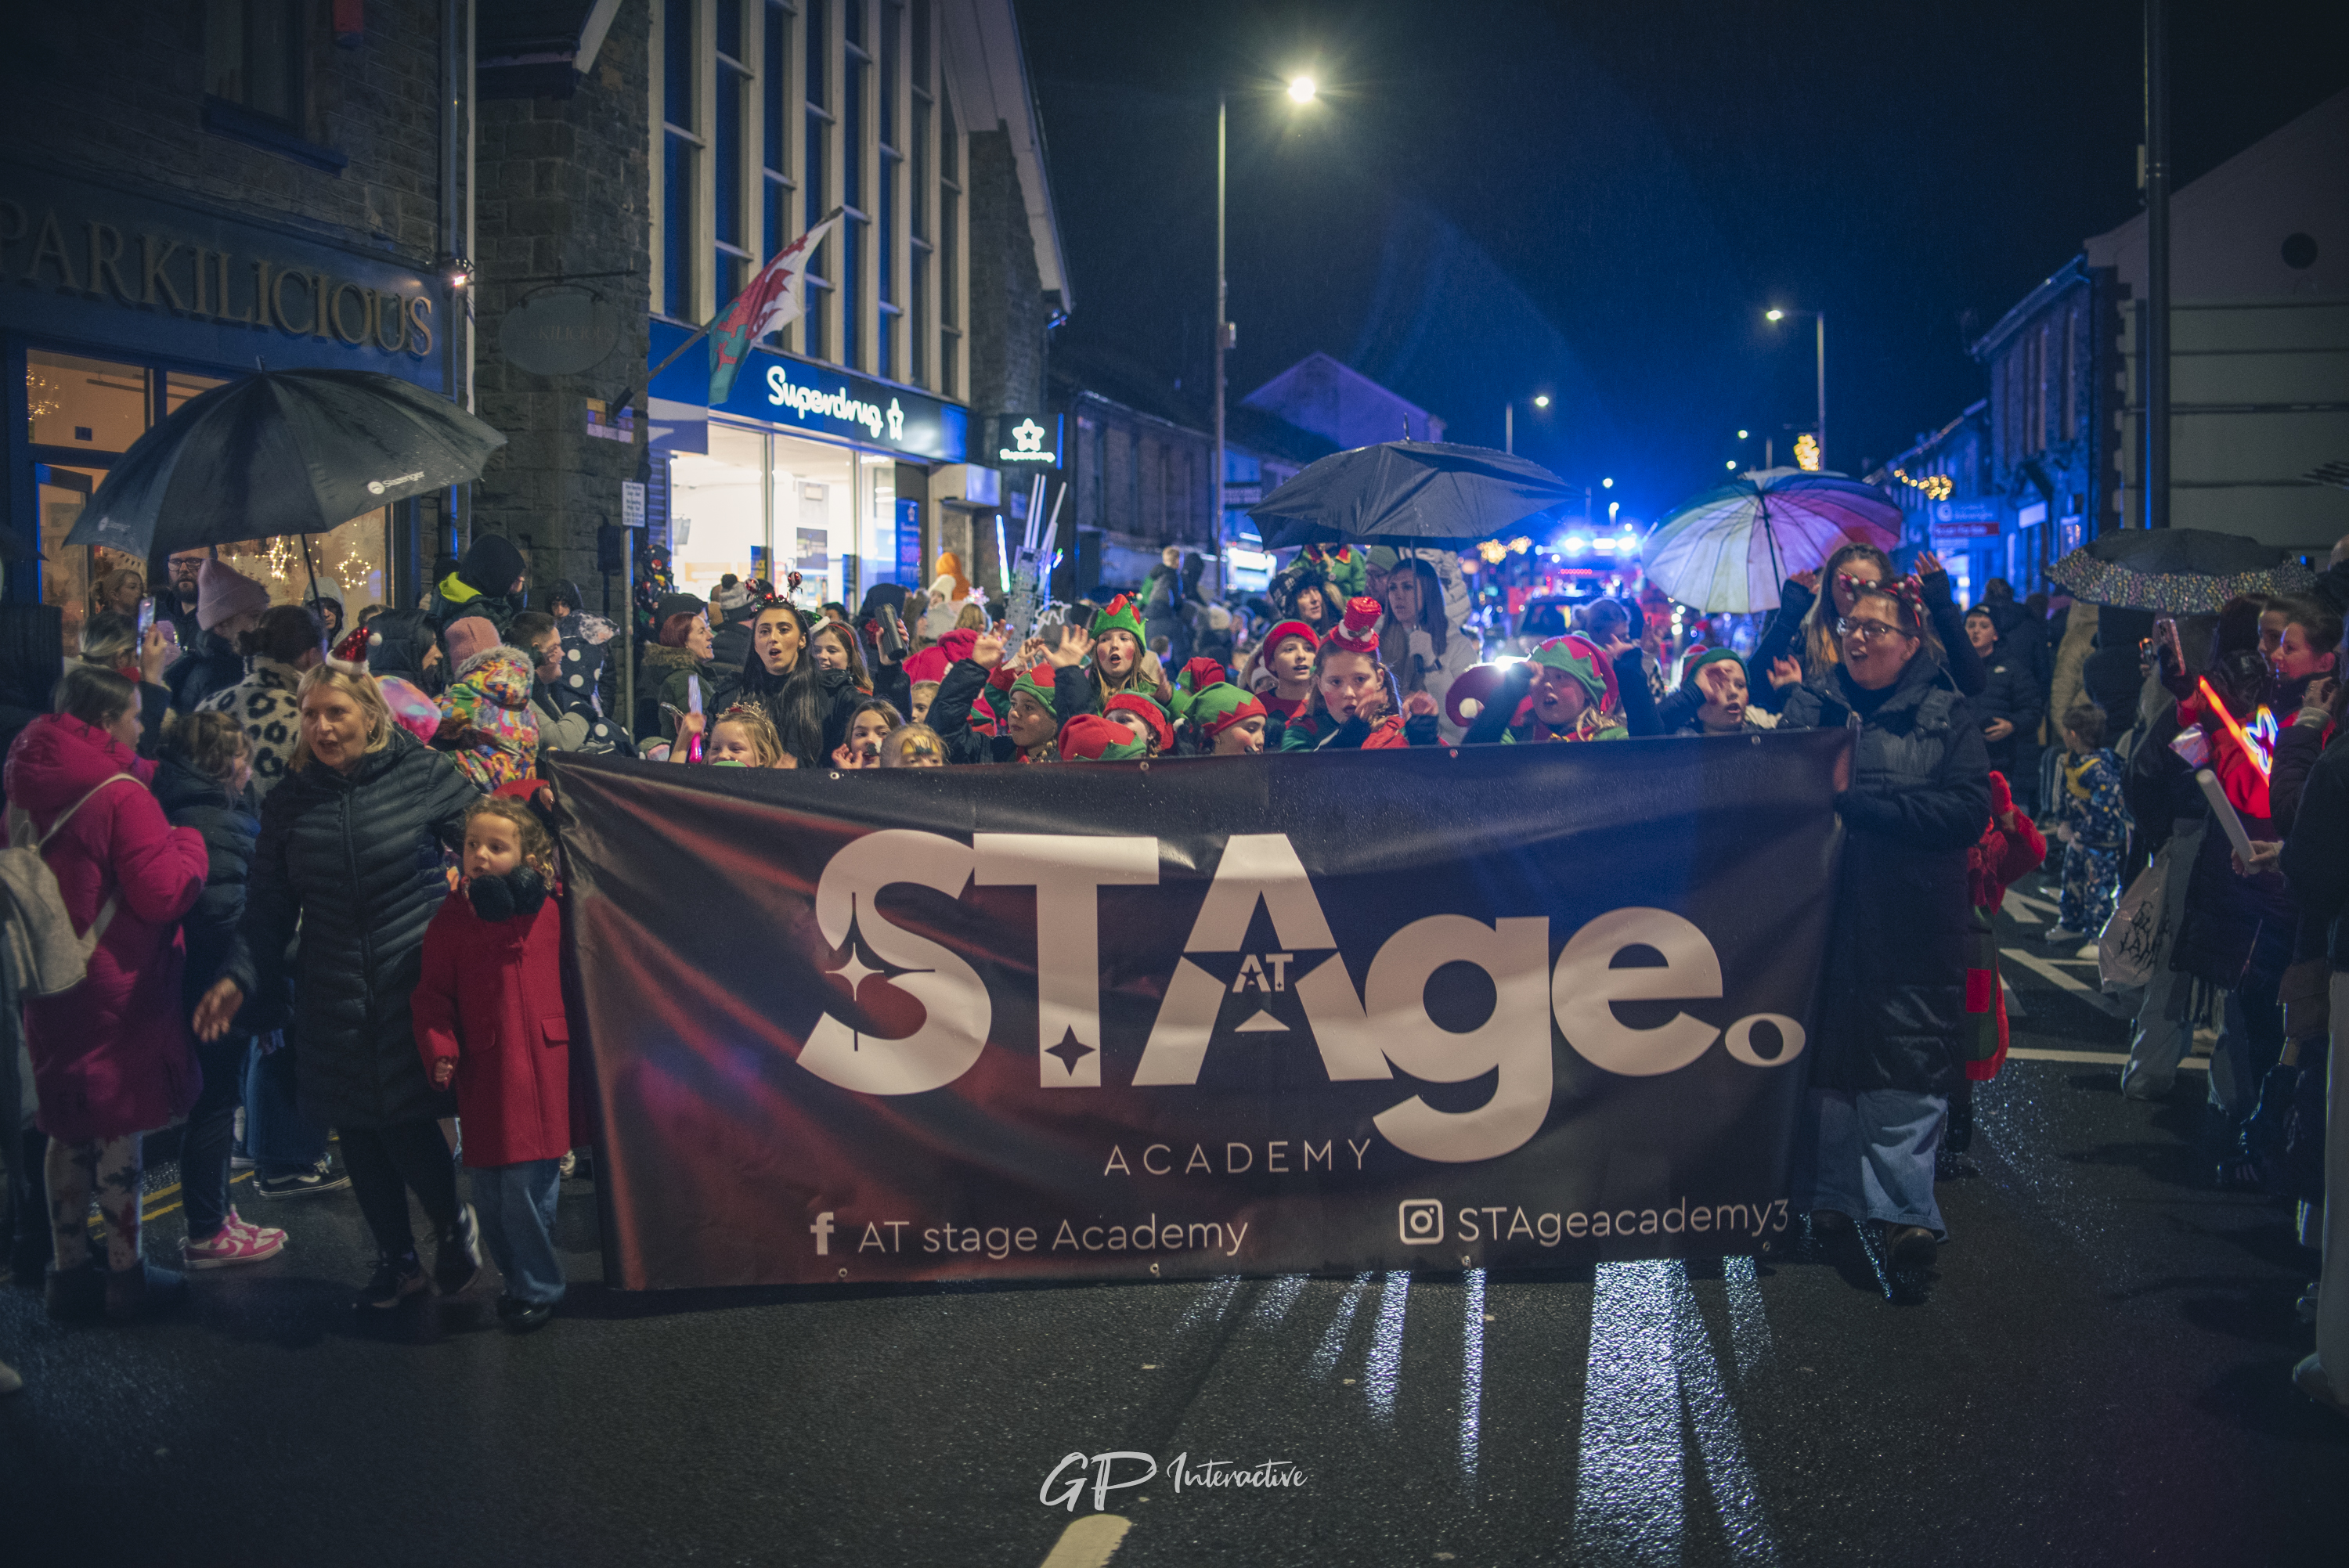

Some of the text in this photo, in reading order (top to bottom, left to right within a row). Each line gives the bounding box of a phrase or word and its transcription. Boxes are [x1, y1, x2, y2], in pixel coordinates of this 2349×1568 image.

[767, 366, 884, 438] Superdrug
[1232, 953, 1294, 993] AT
[1104, 1138, 1371, 1176] ACADEMY
[858, 1220, 910, 1253] AT
[922, 1218, 1037, 1260] stage
[1052, 1213, 1249, 1257] Academy
[1457, 1195, 1789, 1248] STAgeacademy3
